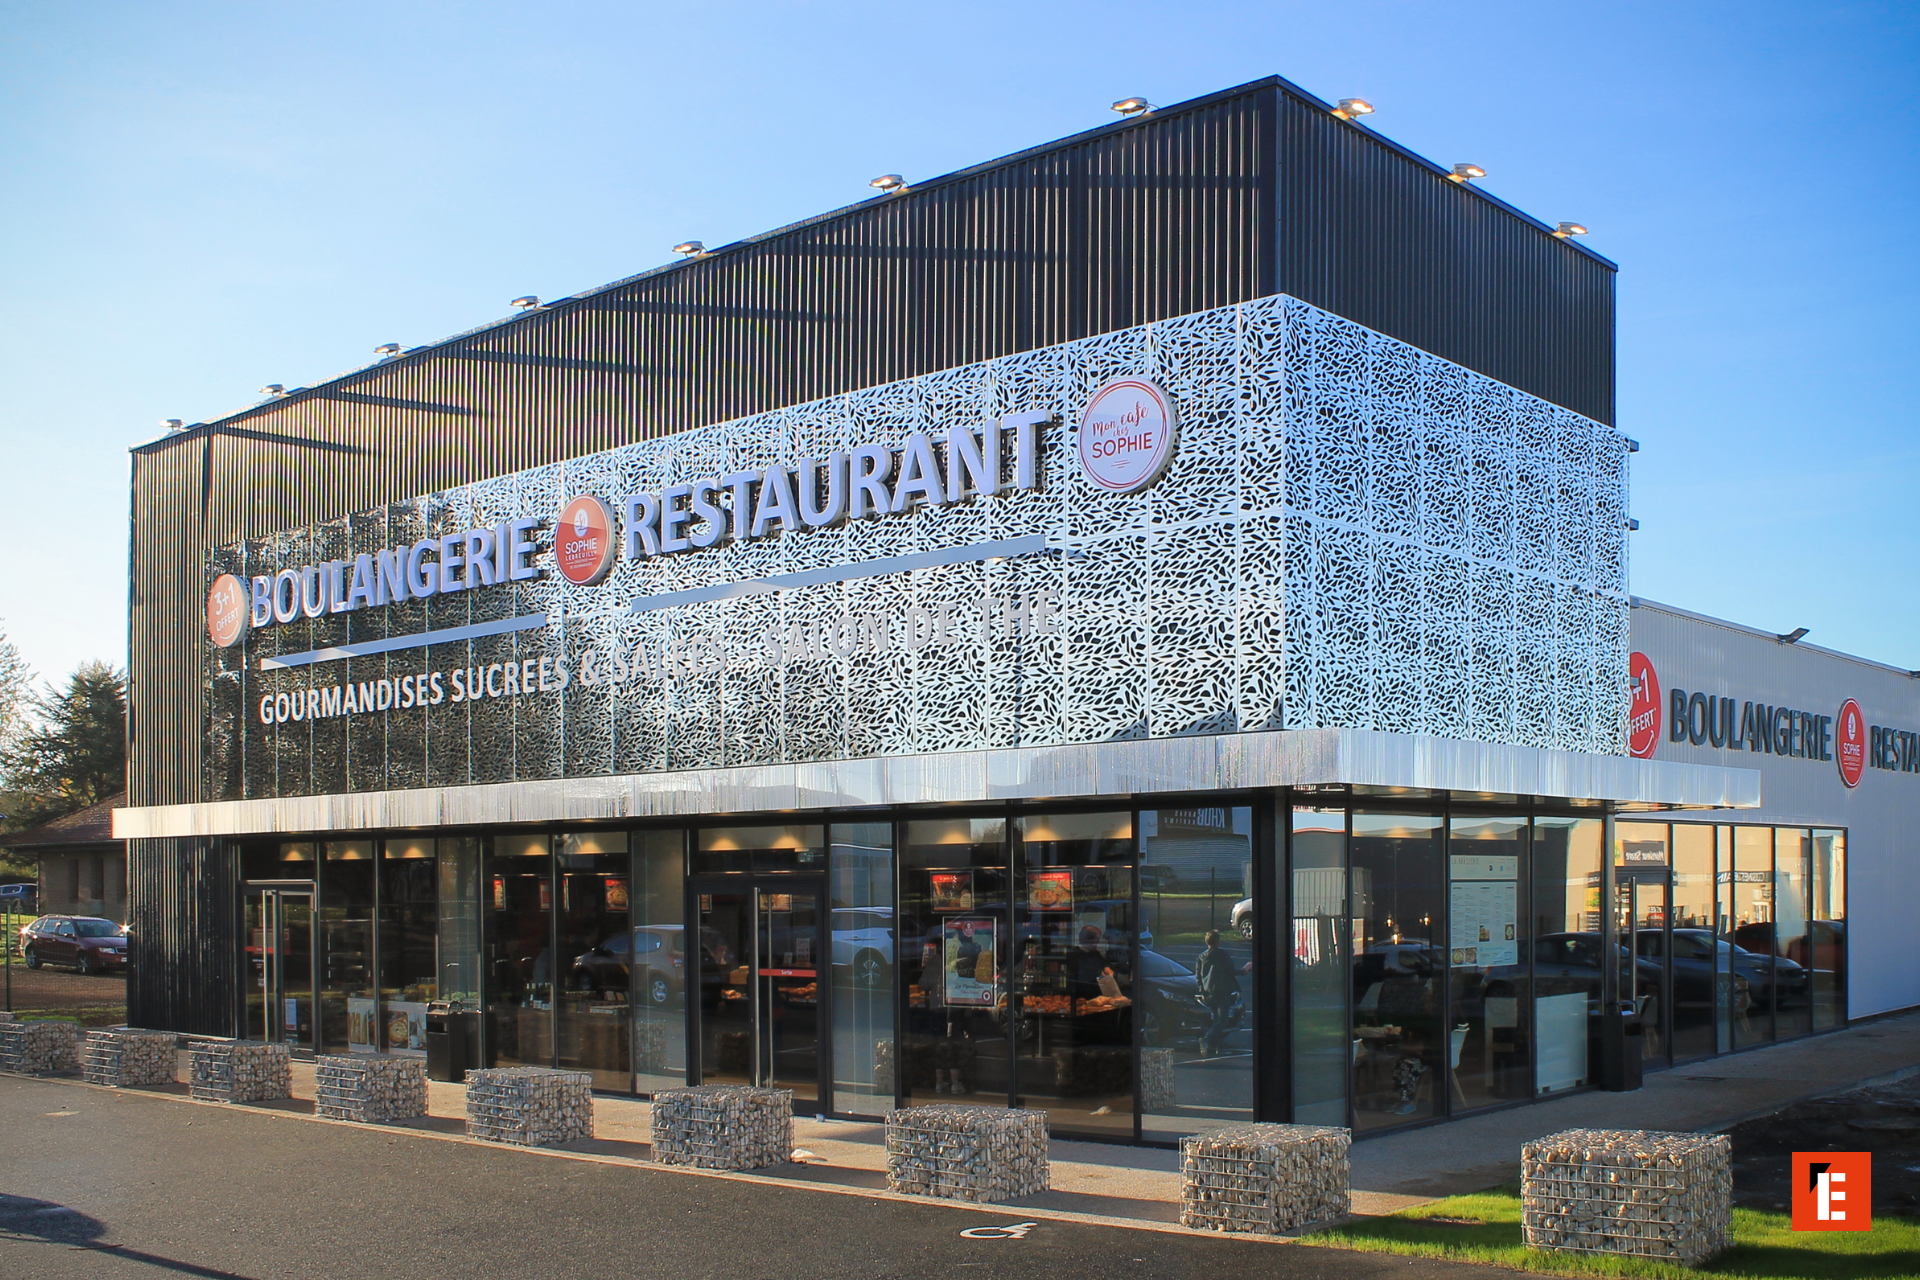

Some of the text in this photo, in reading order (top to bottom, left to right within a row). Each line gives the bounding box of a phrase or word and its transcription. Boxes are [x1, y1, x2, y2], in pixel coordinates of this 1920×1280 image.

[1092, 401, 1149, 437] Mon café
[1113, 426, 1129, 437] chez
[1092, 431, 1153, 459] SOPHIE
[626, 410, 1052, 560] RESTAURANT
[564, 537, 598, 555] SOPHIE
[251, 518, 540, 628] BOULANGERIE
[213, 582, 236, 616] 3+1
[260, 671, 442, 724] GOURMANDISES
[451, 654, 570, 702] SUCREES
[580, 651, 602, 686] &
[613, 633, 728, 683] SALEES
[764, 612, 889, 666] SALON
[907, 602, 958, 648] DE
[974, 590, 1059, 640] THE
[1630, 668, 1650, 711] +1
[1630, 709, 1655, 736] FFERT
[1670, 688, 1920, 774] BOULANGERIE RESTA
[1843, 742, 1860, 756] SOPHIE
